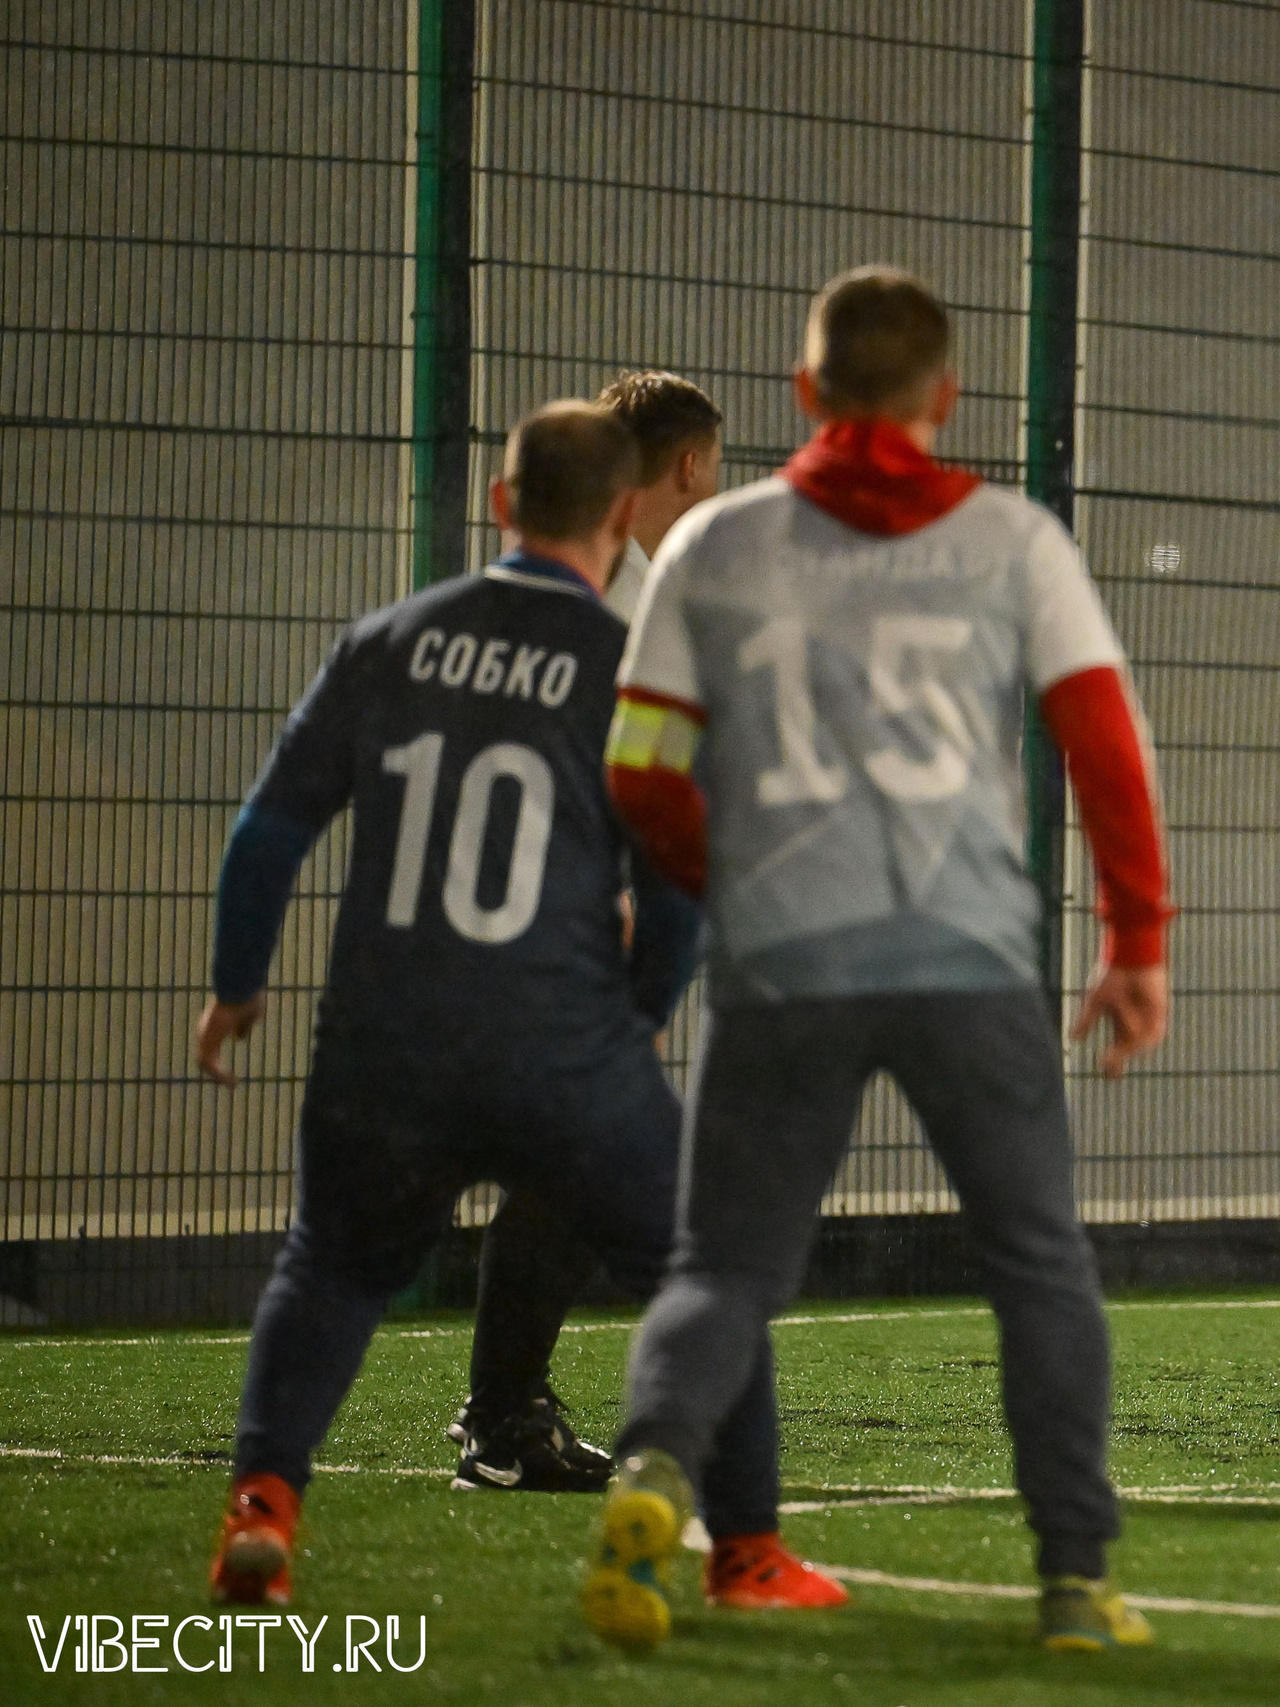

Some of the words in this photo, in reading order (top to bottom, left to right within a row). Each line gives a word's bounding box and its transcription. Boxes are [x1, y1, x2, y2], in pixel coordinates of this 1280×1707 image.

[409, 628, 578, 709] СОБКО
[737, 614, 974, 808] 15
[381, 729, 556, 946] 10
